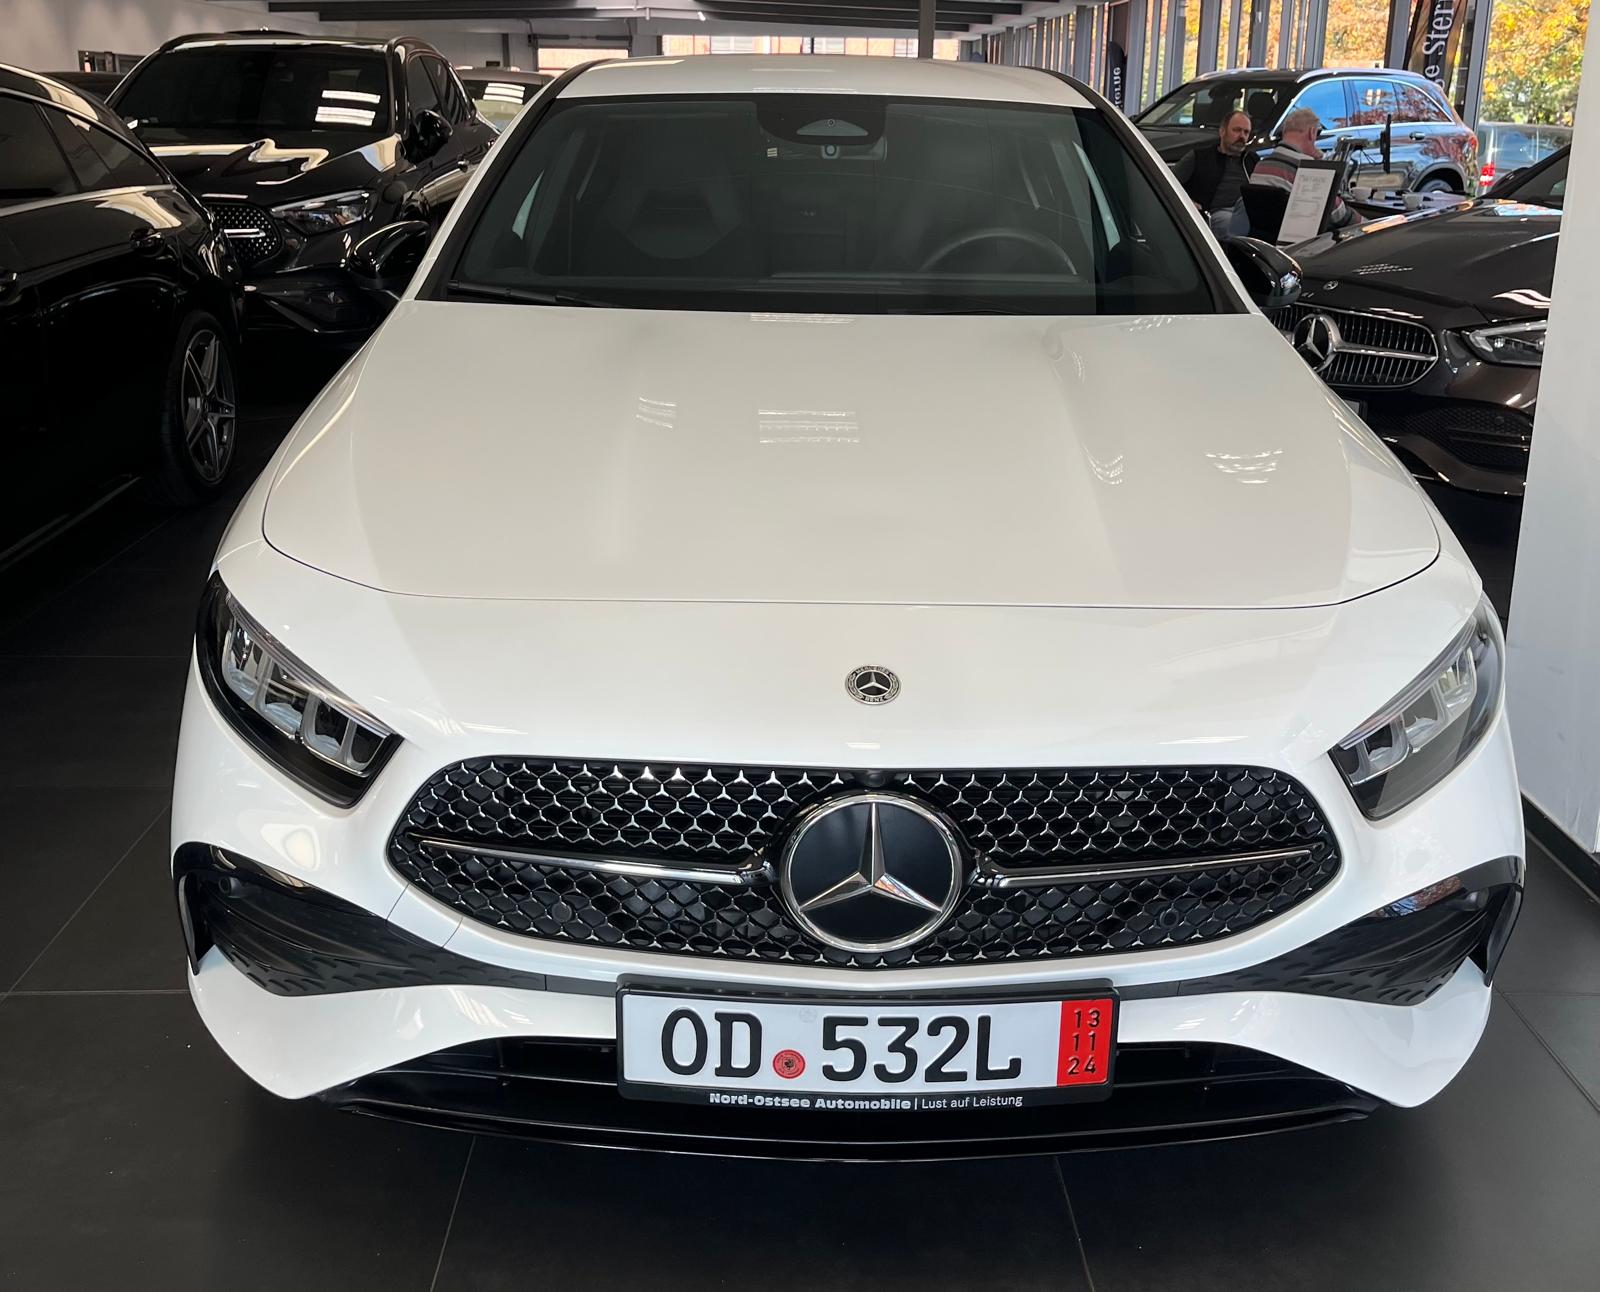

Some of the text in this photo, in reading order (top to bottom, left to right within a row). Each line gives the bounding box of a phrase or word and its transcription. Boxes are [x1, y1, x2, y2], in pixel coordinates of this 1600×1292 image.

[1422, 0, 1454, 55] Ster
[1074, 1009, 1100, 1028] 13
[661, 1007, 762, 1078] OD
[822, 1015, 1021, 1083] 532L
[1072, 1032, 1097, 1052] 11
[1068, 1056, 1096, 1075] 24
[709, 1093, 810, 1108] Nord-Ostsee
[815, 1098, 911, 1110] Automobile
[922, 1098, 946, 1109] Lust
[950, 1098, 970, 1107] auf
[973, 1096, 1023, 1107] Leistung
